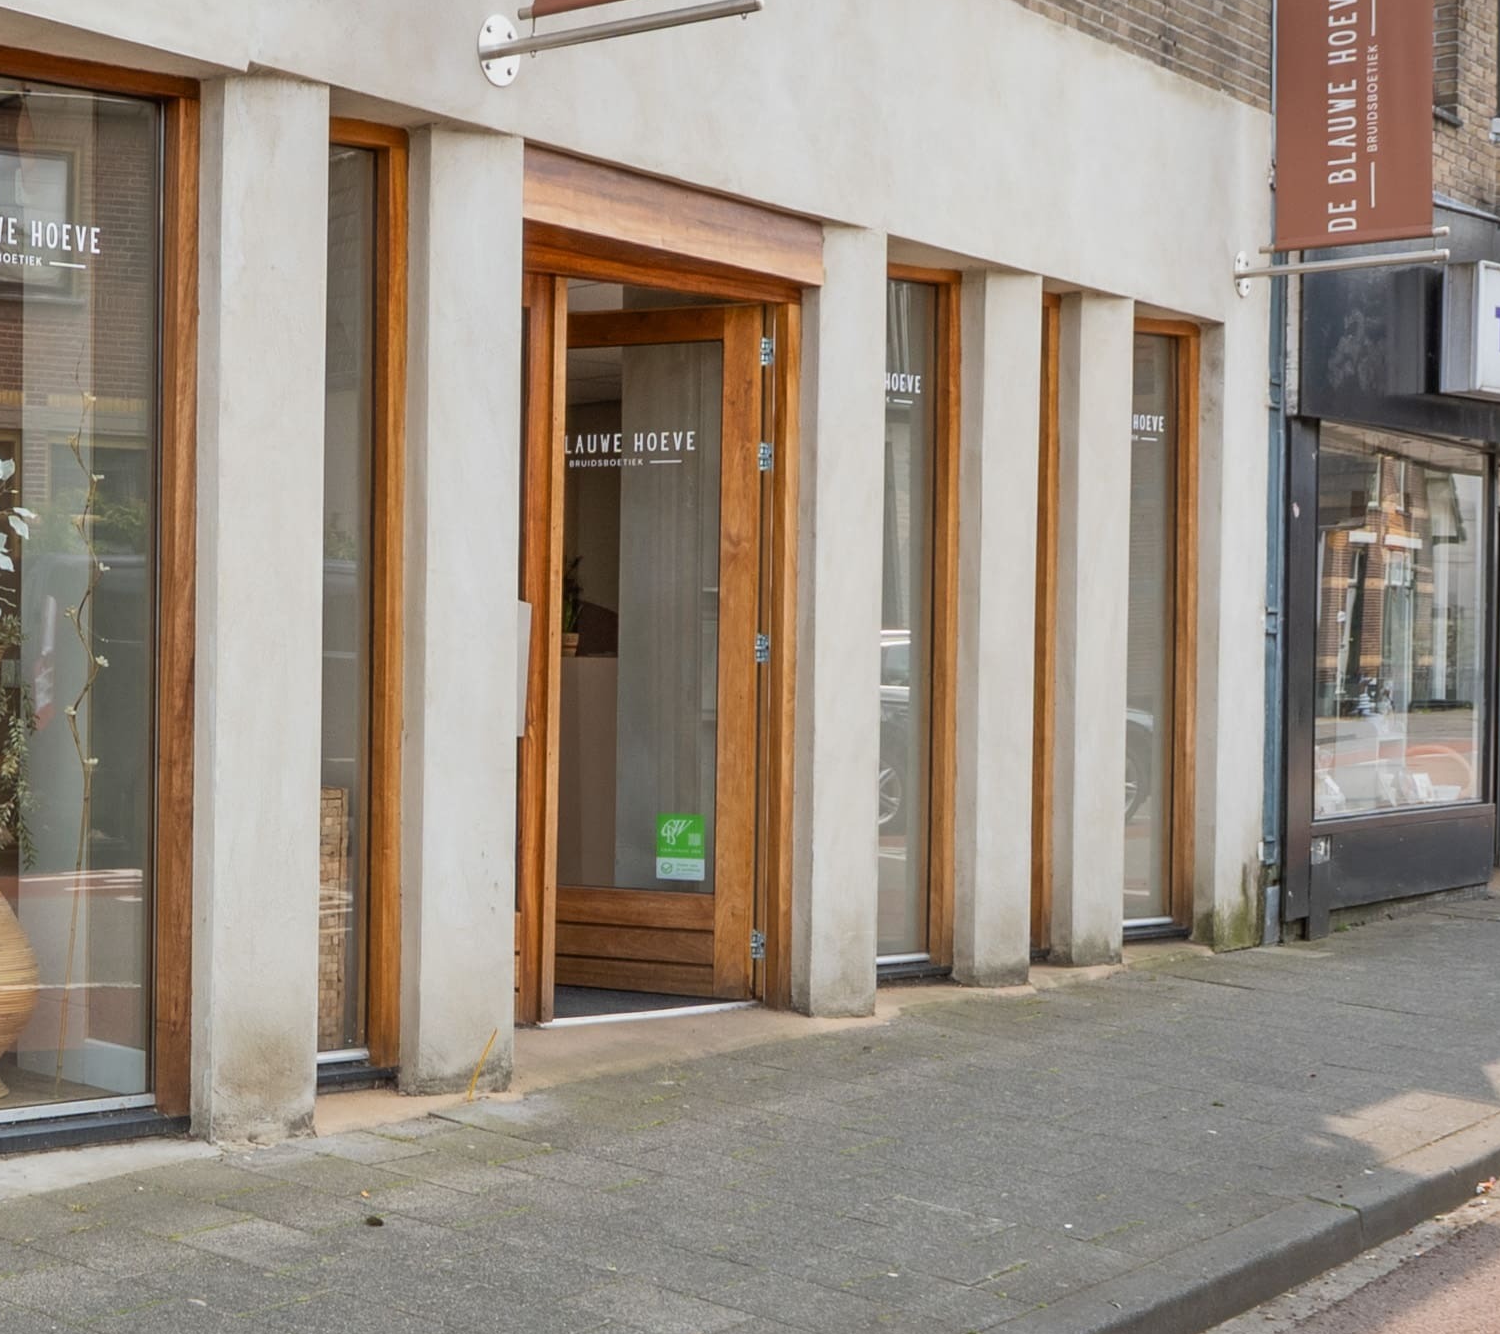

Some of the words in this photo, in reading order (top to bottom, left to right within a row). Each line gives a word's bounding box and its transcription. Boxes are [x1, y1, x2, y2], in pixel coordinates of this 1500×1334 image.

[1366, 44, 1379, 153] BRUIDSBOETIEK
[1327, 78, 1357, 184] BLAUWE
[1328, 199, 1357, 233] DE
[31, 220, 101, 254] HOEVE
[1133, 414, 1164, 432] HOEVE
[564, 433, 622, 455] LAUWE
[634, 431, 696, 453] HOEVE
[569, 458, 644, 468] BRUIDSBOETIEK
